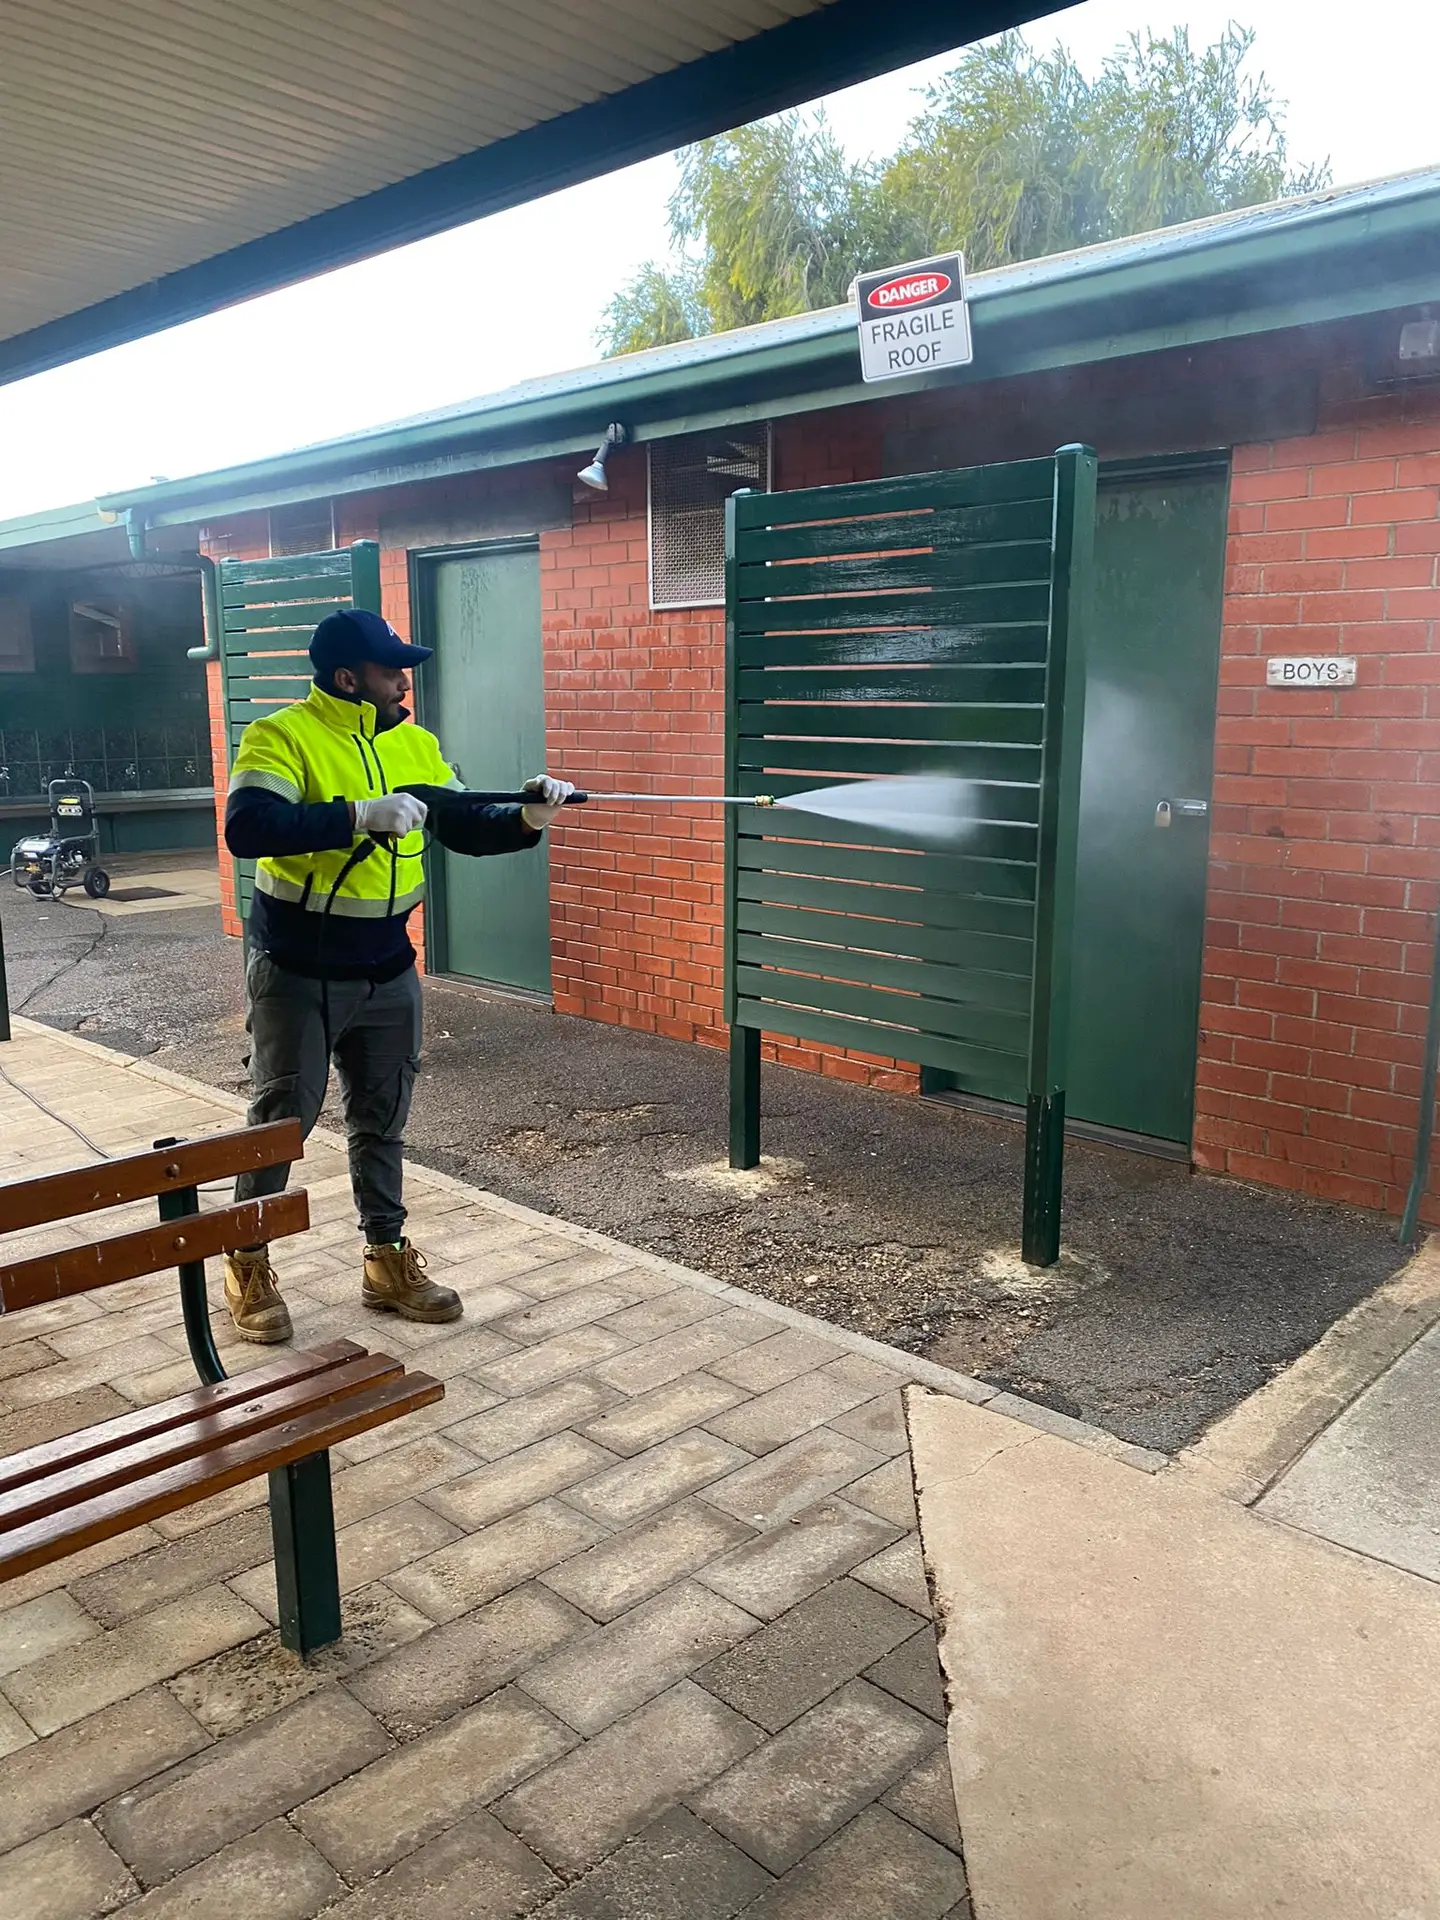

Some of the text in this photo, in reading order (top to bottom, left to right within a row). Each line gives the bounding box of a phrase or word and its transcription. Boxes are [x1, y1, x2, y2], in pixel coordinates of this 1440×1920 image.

[878, 278, 939, 304] DANGER
[872, 309, 954, 344] FRAGILE
[888, 341, 941, 369] ROOF
[1283, 663, 1338, 680] BOYS
